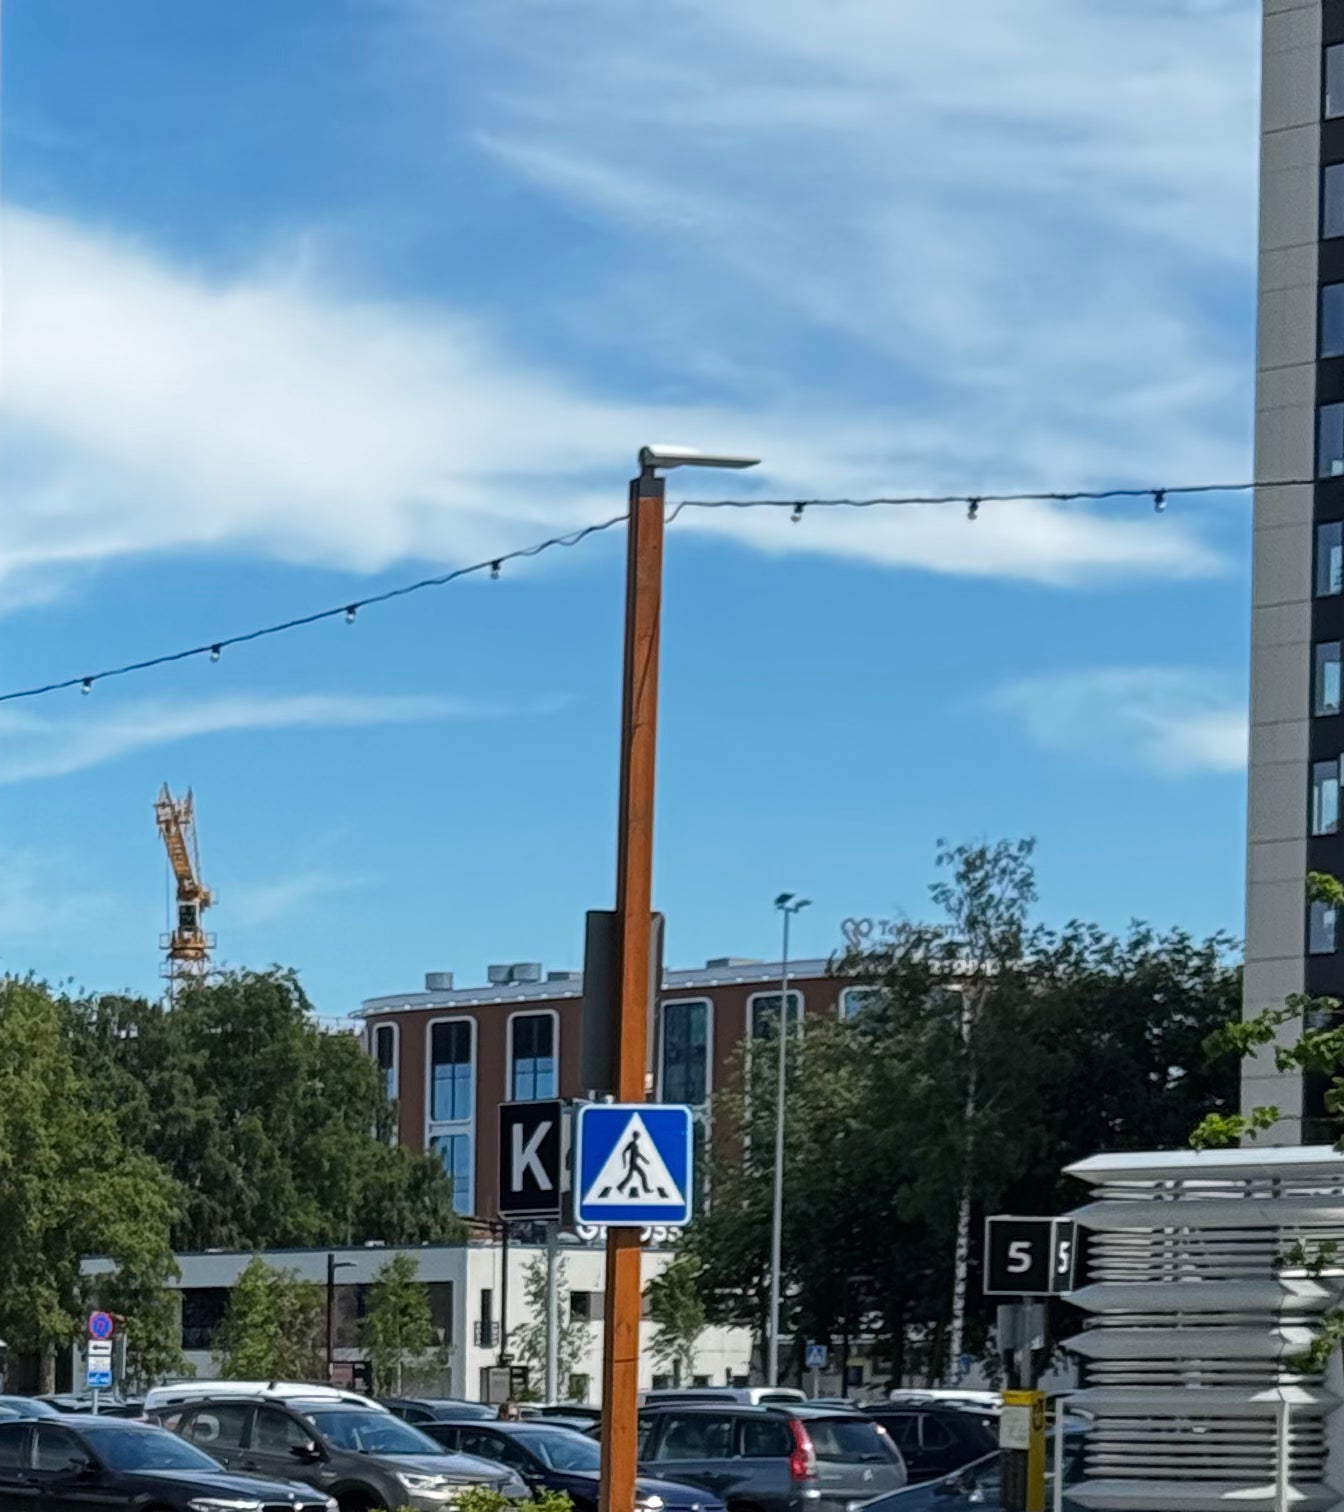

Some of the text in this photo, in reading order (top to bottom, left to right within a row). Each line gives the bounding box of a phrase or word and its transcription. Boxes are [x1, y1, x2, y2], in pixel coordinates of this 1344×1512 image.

[510, 1120, 553, 1193] K
[1006, 1240, 1033, 1274] 5
[1057, 1240, 1072, 1275] 5
